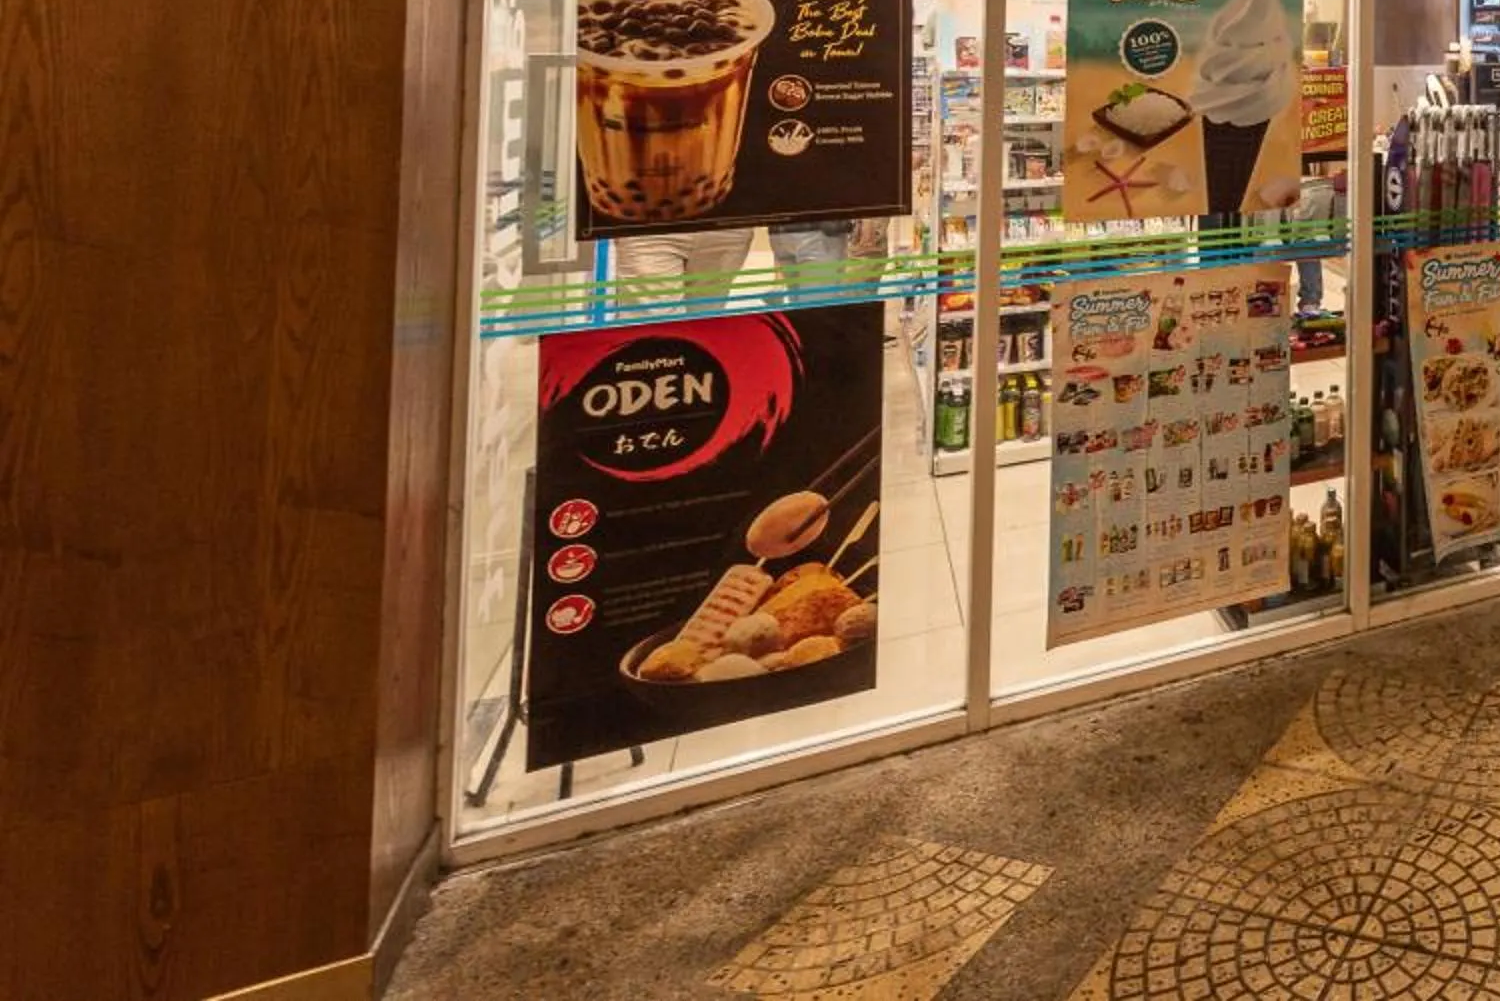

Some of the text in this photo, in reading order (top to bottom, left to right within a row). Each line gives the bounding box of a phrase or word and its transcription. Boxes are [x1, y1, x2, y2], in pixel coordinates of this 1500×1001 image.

[828, 1, 869, 22] Best
[1071, 296, 1149, 319] Summer
[615, 355, 684, 373] FamilyMart
[583, 372, 713, 417] ODEN
